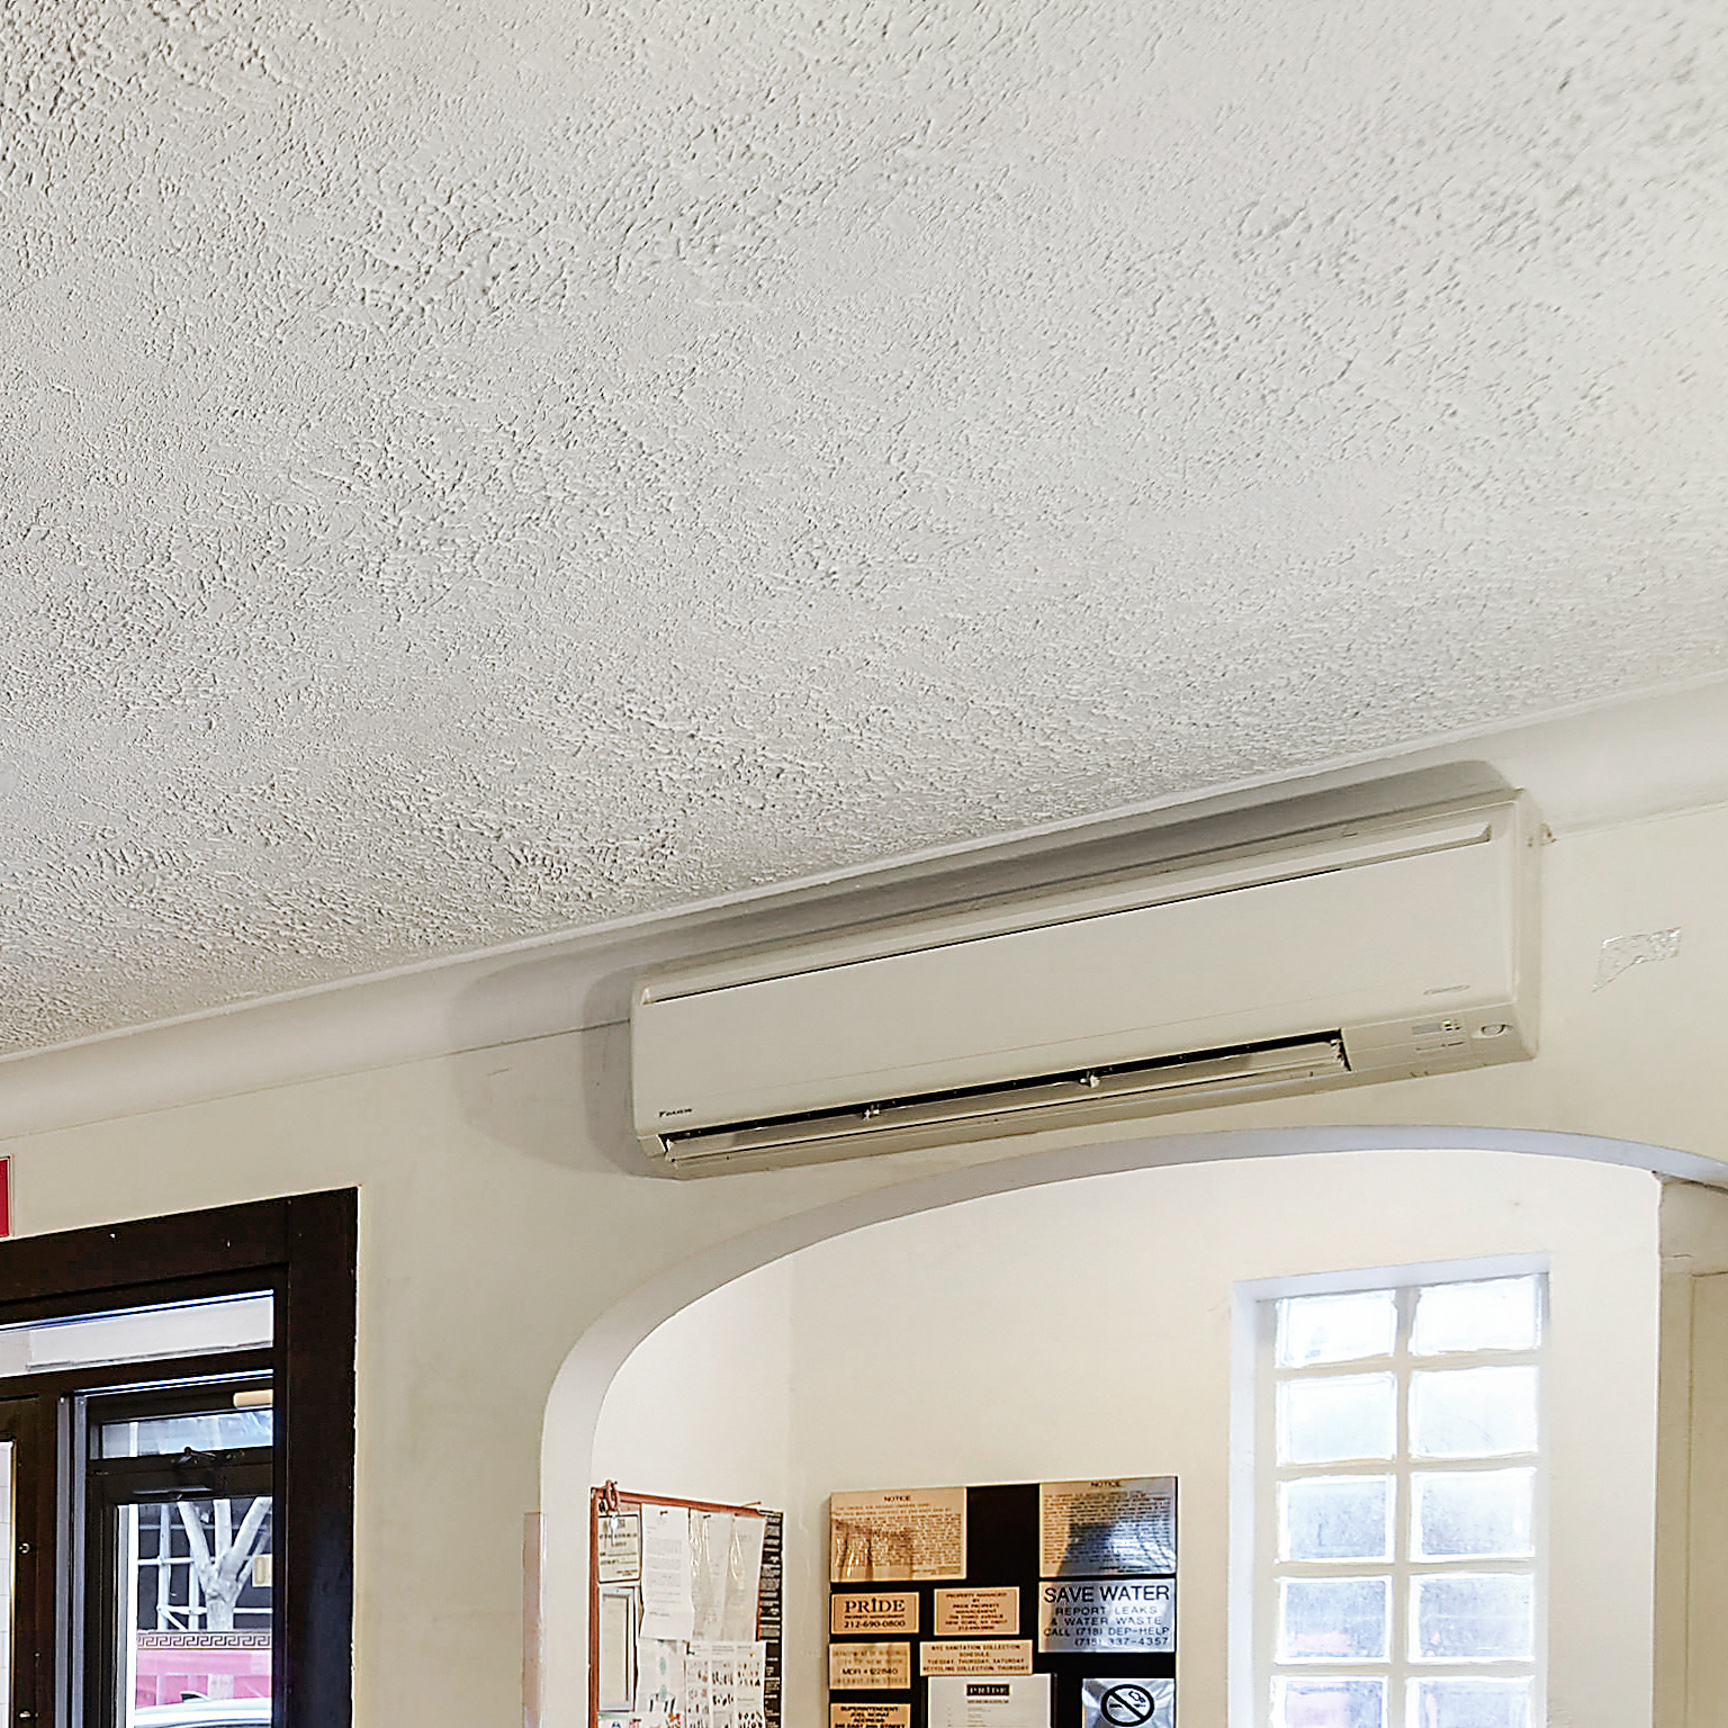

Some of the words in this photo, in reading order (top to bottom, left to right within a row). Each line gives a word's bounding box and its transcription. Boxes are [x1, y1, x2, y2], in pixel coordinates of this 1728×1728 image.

[1043, 1587, 1094, 1603] SAVE
[1099, 1585, 1170, 1601] WATER
[845, 1597, 905, 1613] PRIDE
[1055, 1606, 1106, 1616] REPORT
[1115, 1606, 1158, 1614] LEAKS
[1064, 1617, 1109, 1626] WATER
[1116, 1617, 1162, 1625] WASTE
[1043, 1628, 1070, 1637] CALL
[1076, 1627, 1103, 1636] (718)
[1108, 1627, 1170, 1636] DEP-HELP
